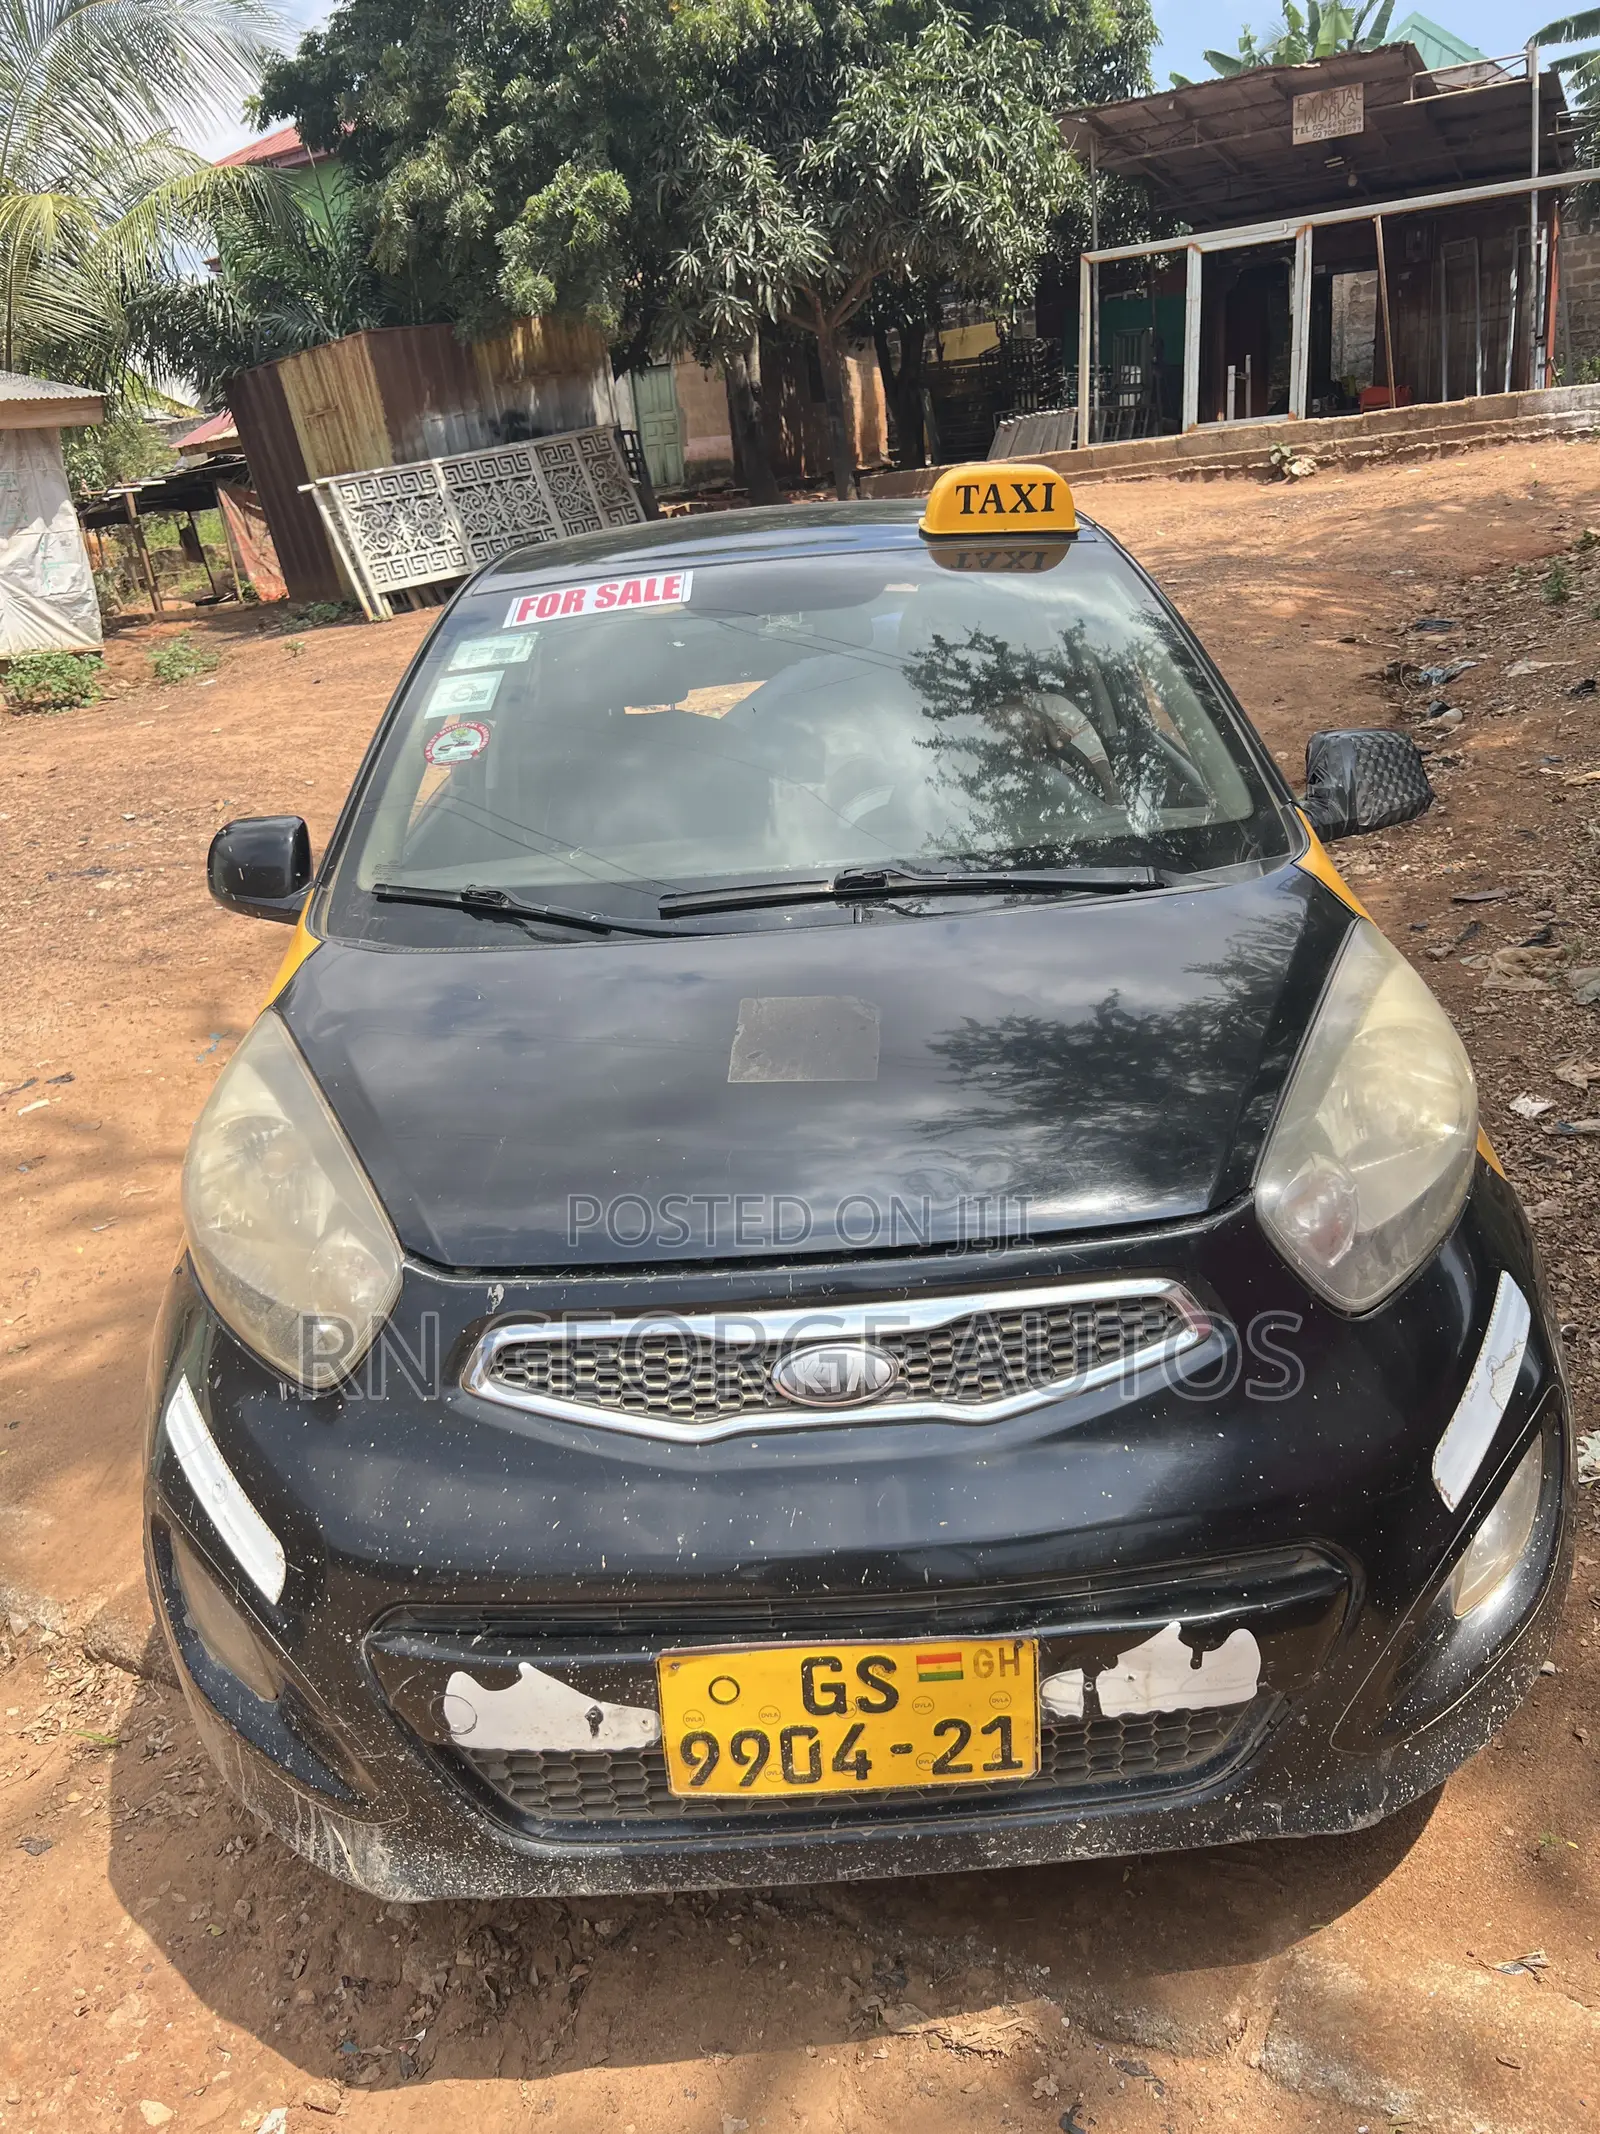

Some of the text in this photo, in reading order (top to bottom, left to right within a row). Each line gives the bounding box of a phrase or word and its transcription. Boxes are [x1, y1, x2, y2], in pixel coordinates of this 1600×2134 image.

[1320, 86, 1362, 107] METAL
[1304, 102, 1356, 126] WORKS
[955, 482, 1056, 515] TAXI
[516, 575, 682, 623] FOR SALE
[792, 1357, 879, 1395] KIA
[973, 1647, 1021, 1679] GH
[801, 1655, 899, 1716] GS
[992, 1697, 1010, 1705] DVLA
[914, 1701, 933, 1709] DVLA
[680, 1715, 1023, 1787] 9904-21
